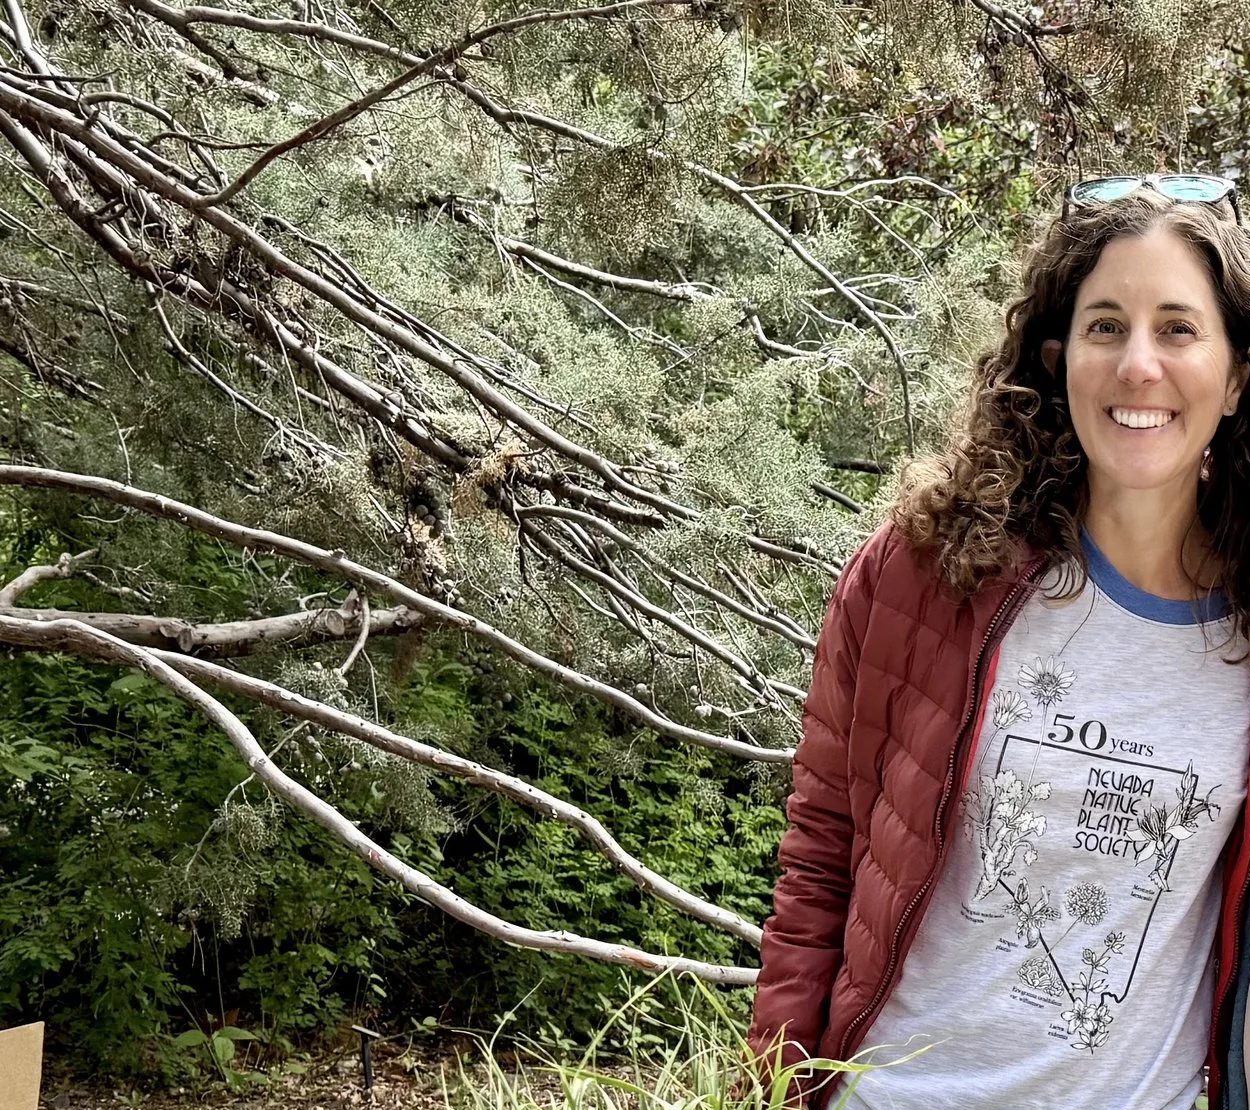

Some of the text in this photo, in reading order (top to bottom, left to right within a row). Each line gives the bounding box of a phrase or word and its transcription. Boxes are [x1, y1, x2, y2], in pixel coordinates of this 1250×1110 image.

[1048, 713, 1154, 759] 50 years
[1088, 768, 1154, 797] NEVADA
[1082, 791, 1139, 815] NATIVE
[1077, 812, 1133, 836] PLANT
[1073, 832, 1147, 860] SOCIETY
